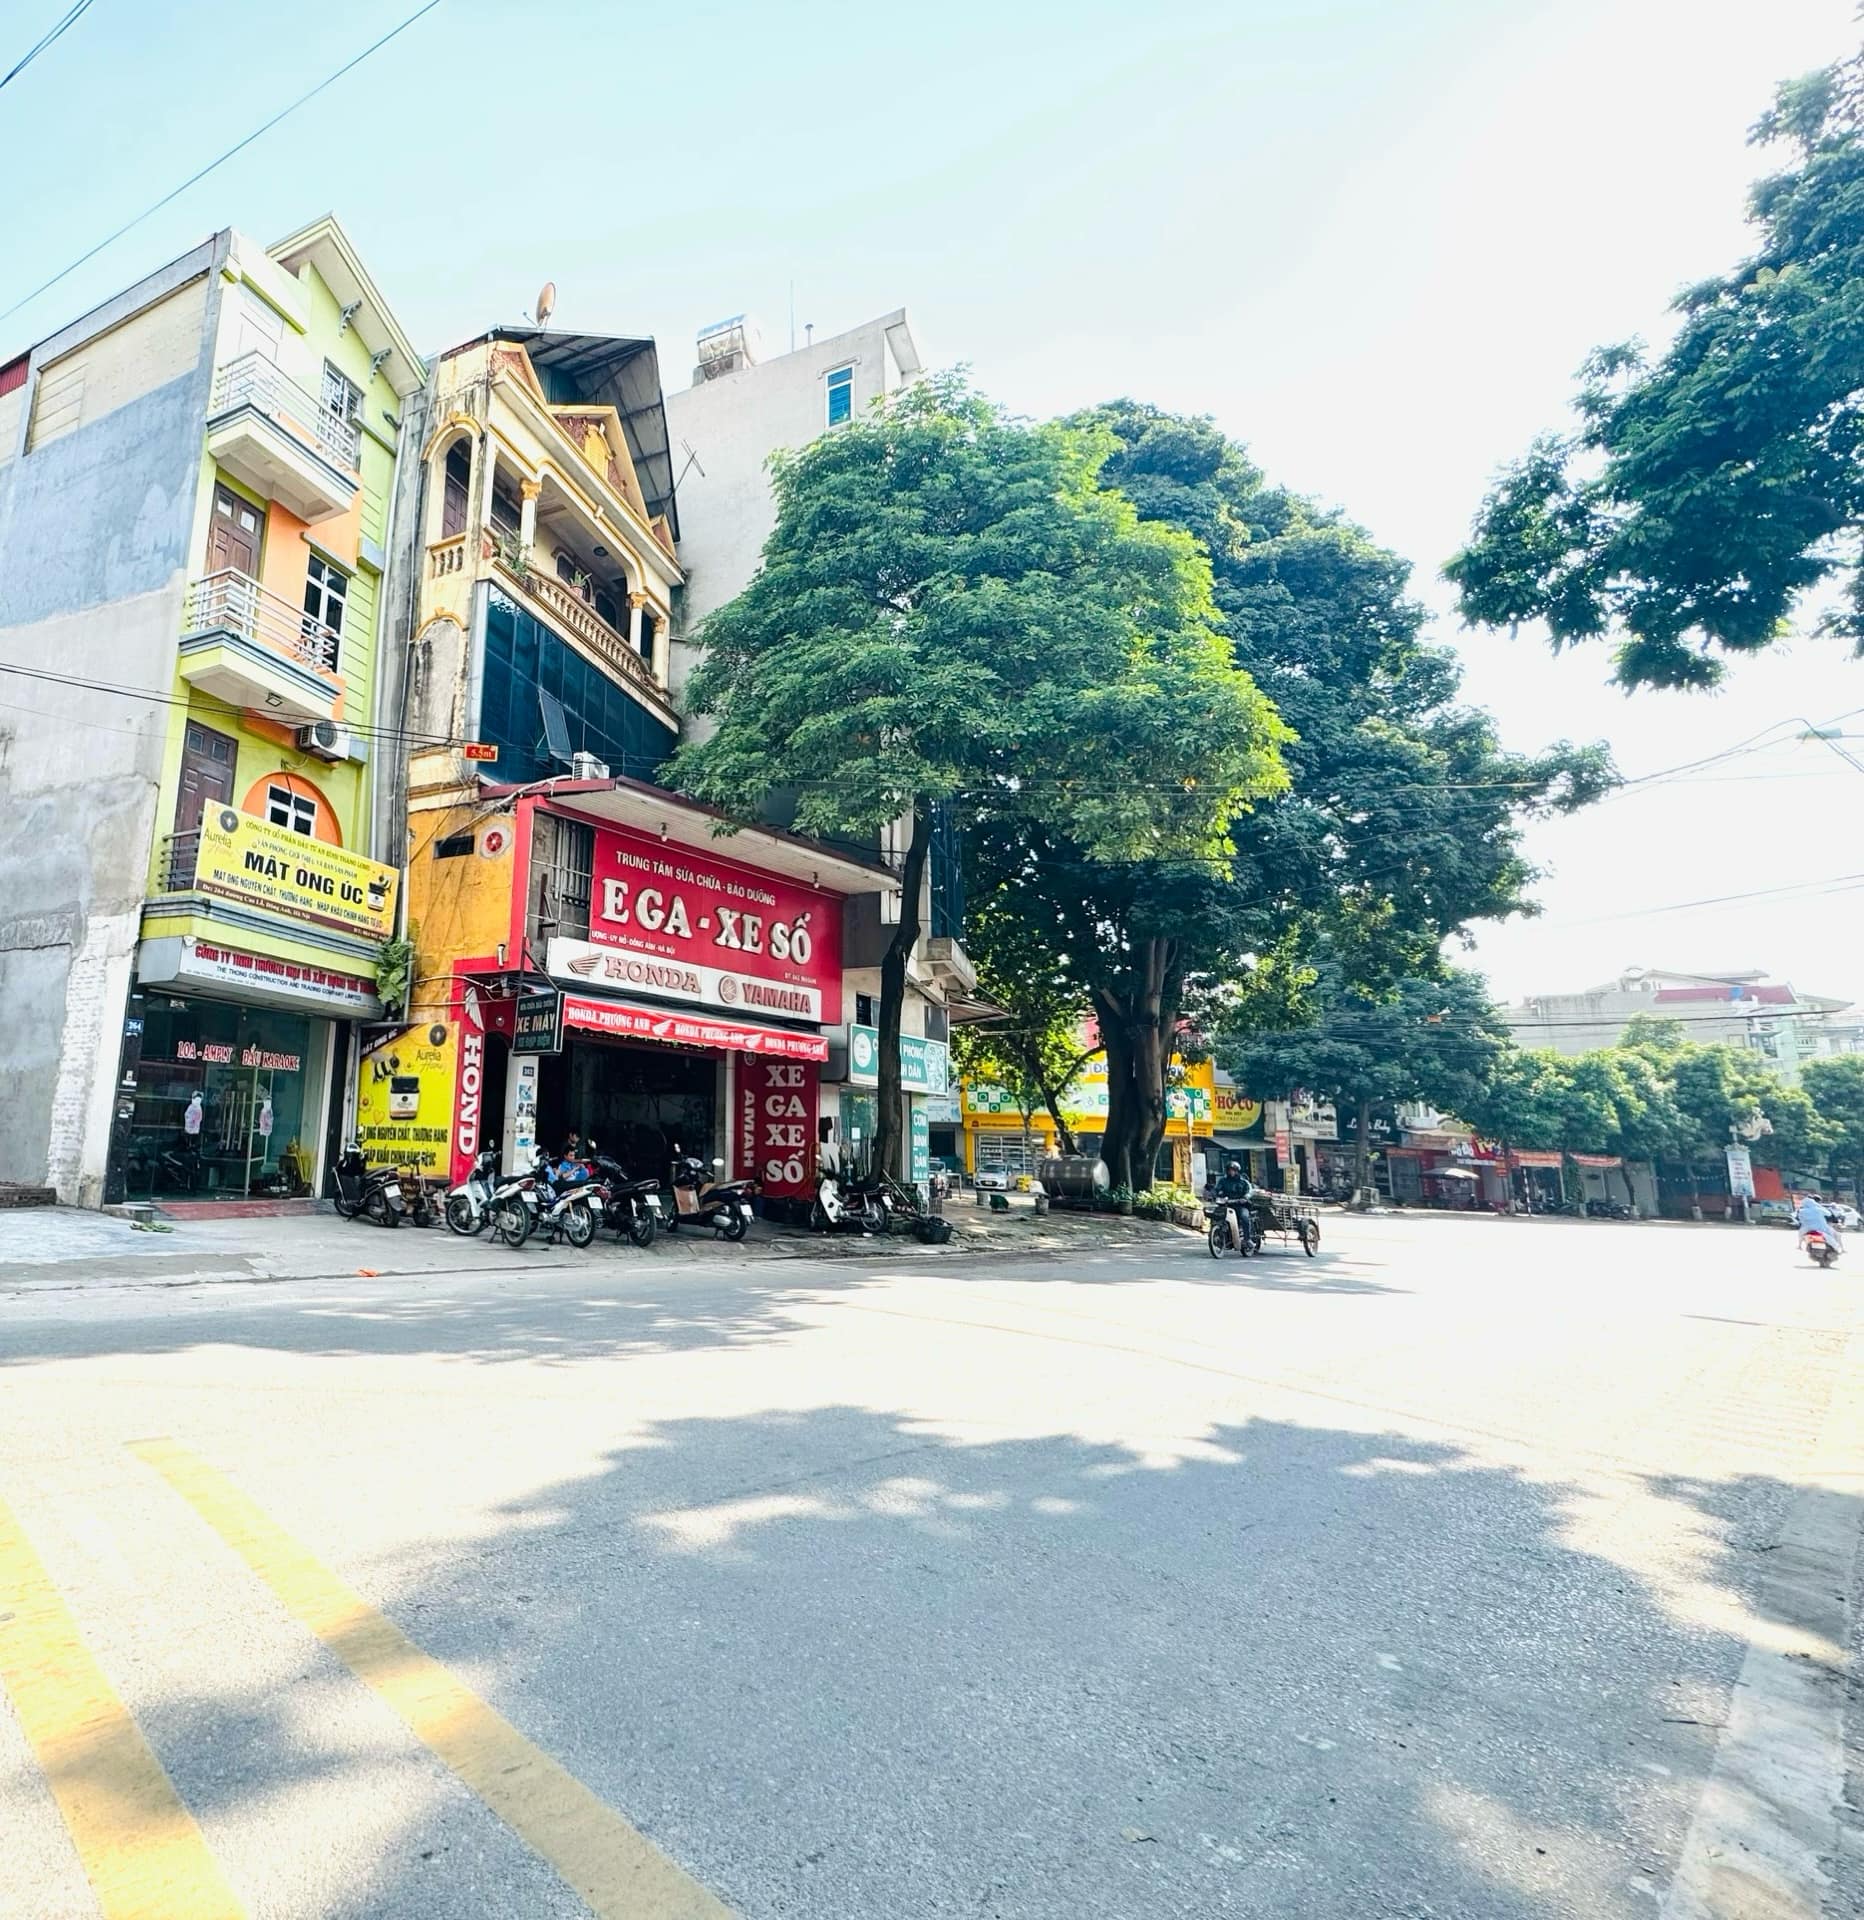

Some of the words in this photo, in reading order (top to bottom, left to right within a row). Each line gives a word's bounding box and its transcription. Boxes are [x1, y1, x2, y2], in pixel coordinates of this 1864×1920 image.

[204, 828, 232, 848] Aurelia
[245, 850, 290, 881] MẬT
[295, 868, 335, 896] ONG
[341, 880, 364, 904] ÚC
[616, 851, 650, 871] TRUNG
[652, 859, 674, 877] TÂM
[675, 865, 695, 884] SỬA
[696, 872, 722, 892] CHỮA
[726, 879, 745, 898] BẢO
[746, 886, 776, 907] DƯỠNG
[714, 906, 763, 955] XE
[770, 912, 813, 965] SỐ
[216, 966, 227, 974] THE
[229, 968, 247, 978] THONG
[248, 973, 288, 986] CONSTRUCTION
[289, 980, 299, 989] AND
[301, 983, 321, 993] TRADING
[322, 988, 344, 997] COMPANY
[604, 955, 701, 994] HONDA
[742, 981, 812, 1014] YAMAHA
[516, 1016, 530, 1033] XE
[532, 1010, 555, 1032] MÁY
[568, 1007, 597, 1022] HONDA
[598, 1011, 632, 1028] PHƯƠNG
[633, 1017, 650, 1031] ANH
[675, 1023, 700, 1038] HONDA
[765, 1036, 786, 1050] HONDA
[177, 1040, 197, 1060] LOA
[202, 1043, 234, 1063] AMPLY
[261, 1050, 301, 1072] KARAOKE
[416, 1048, 442, 1061] Aurelia
[902, 1041, 925, 1060] PHÒNG
[765, 1065, 806, 1087] XE
[458, 1034, 482, 1155] HOND
[765, 1094, 808, 1117] GA
[744, 1089, 755, 1167] AMAH
[765, 1123, 806, 1147] XE
[766, 1150, 804, 1183] SỐ
